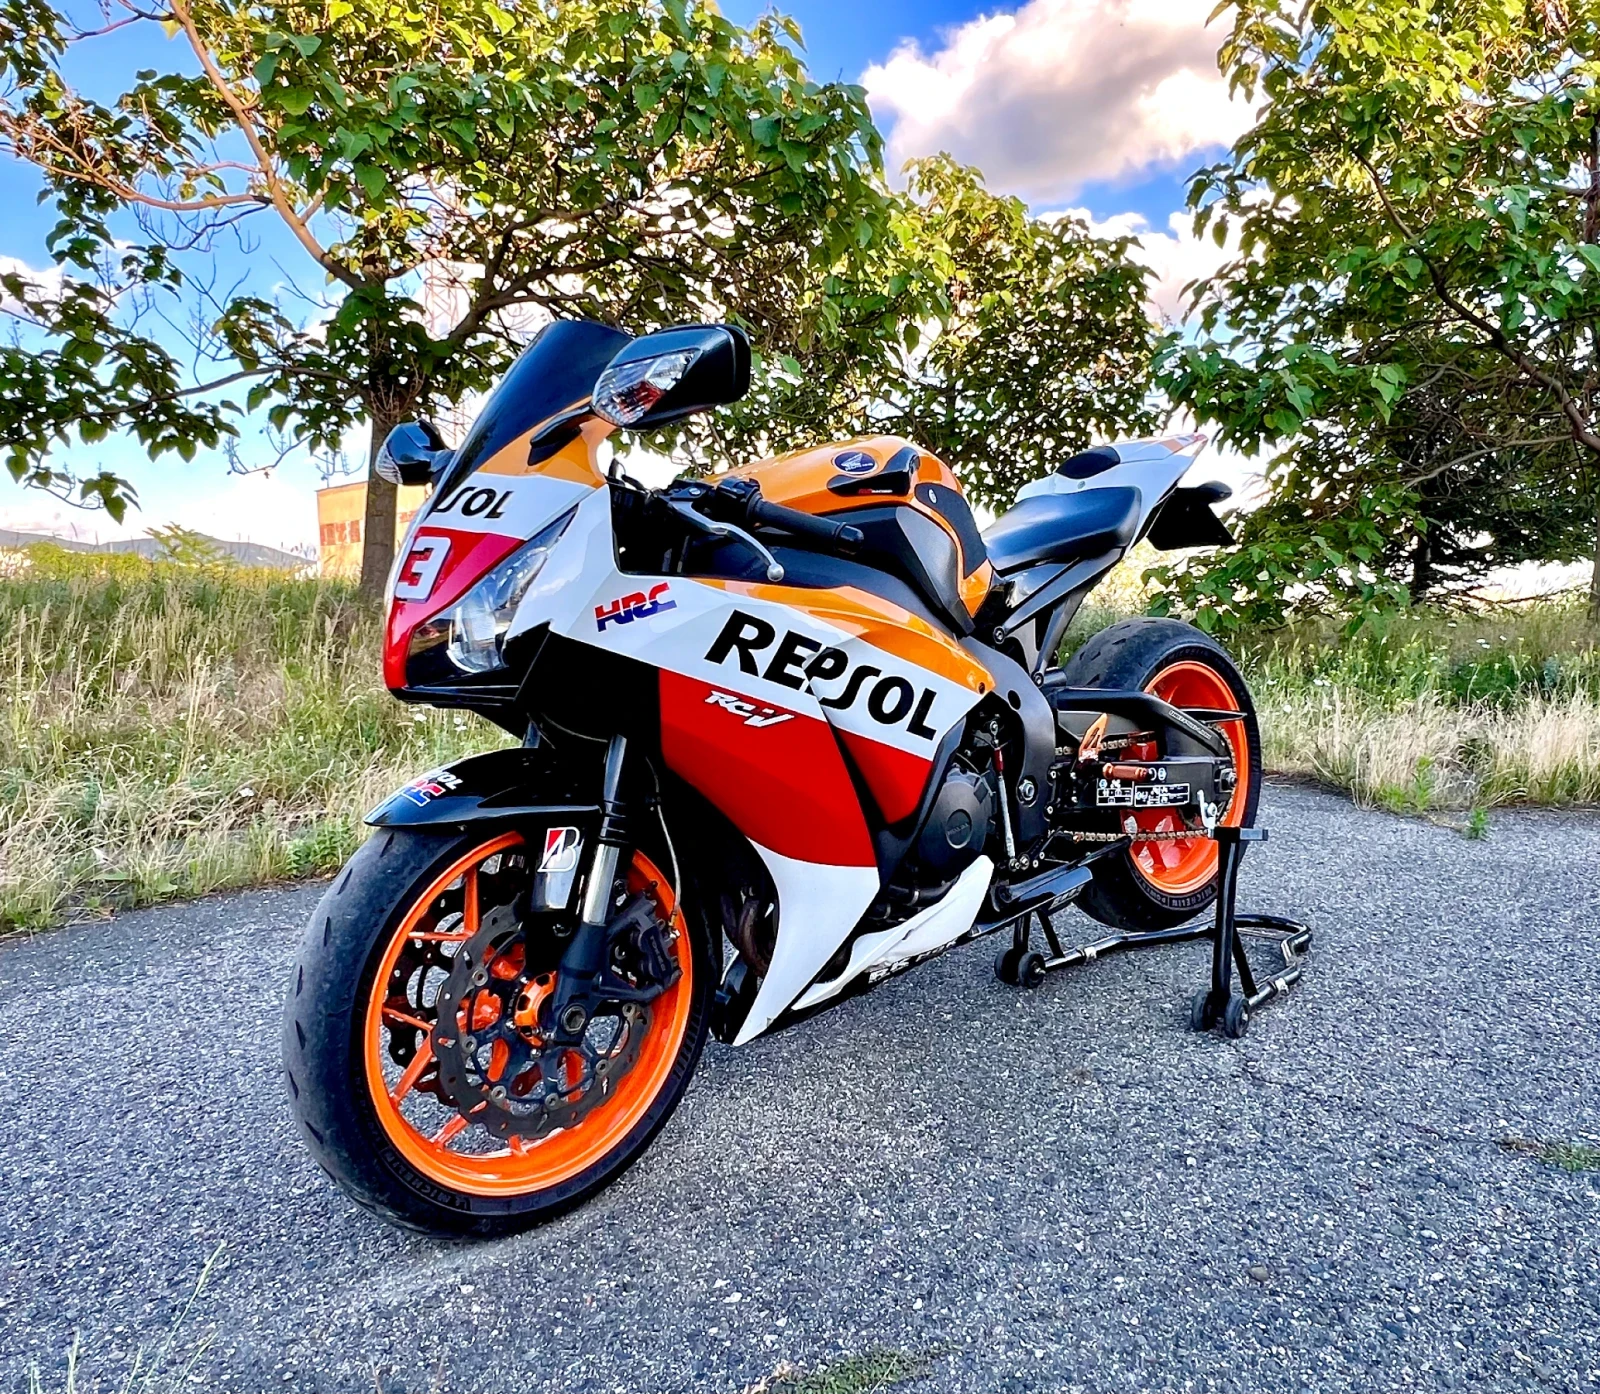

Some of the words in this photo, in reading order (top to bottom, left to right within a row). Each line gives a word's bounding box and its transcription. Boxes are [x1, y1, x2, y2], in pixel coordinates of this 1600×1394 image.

[595, 582, 677, 633] HRC
[703, 609, 938, 741] REPSOL
[383, 1149, 452, 1204] MICHELIN
